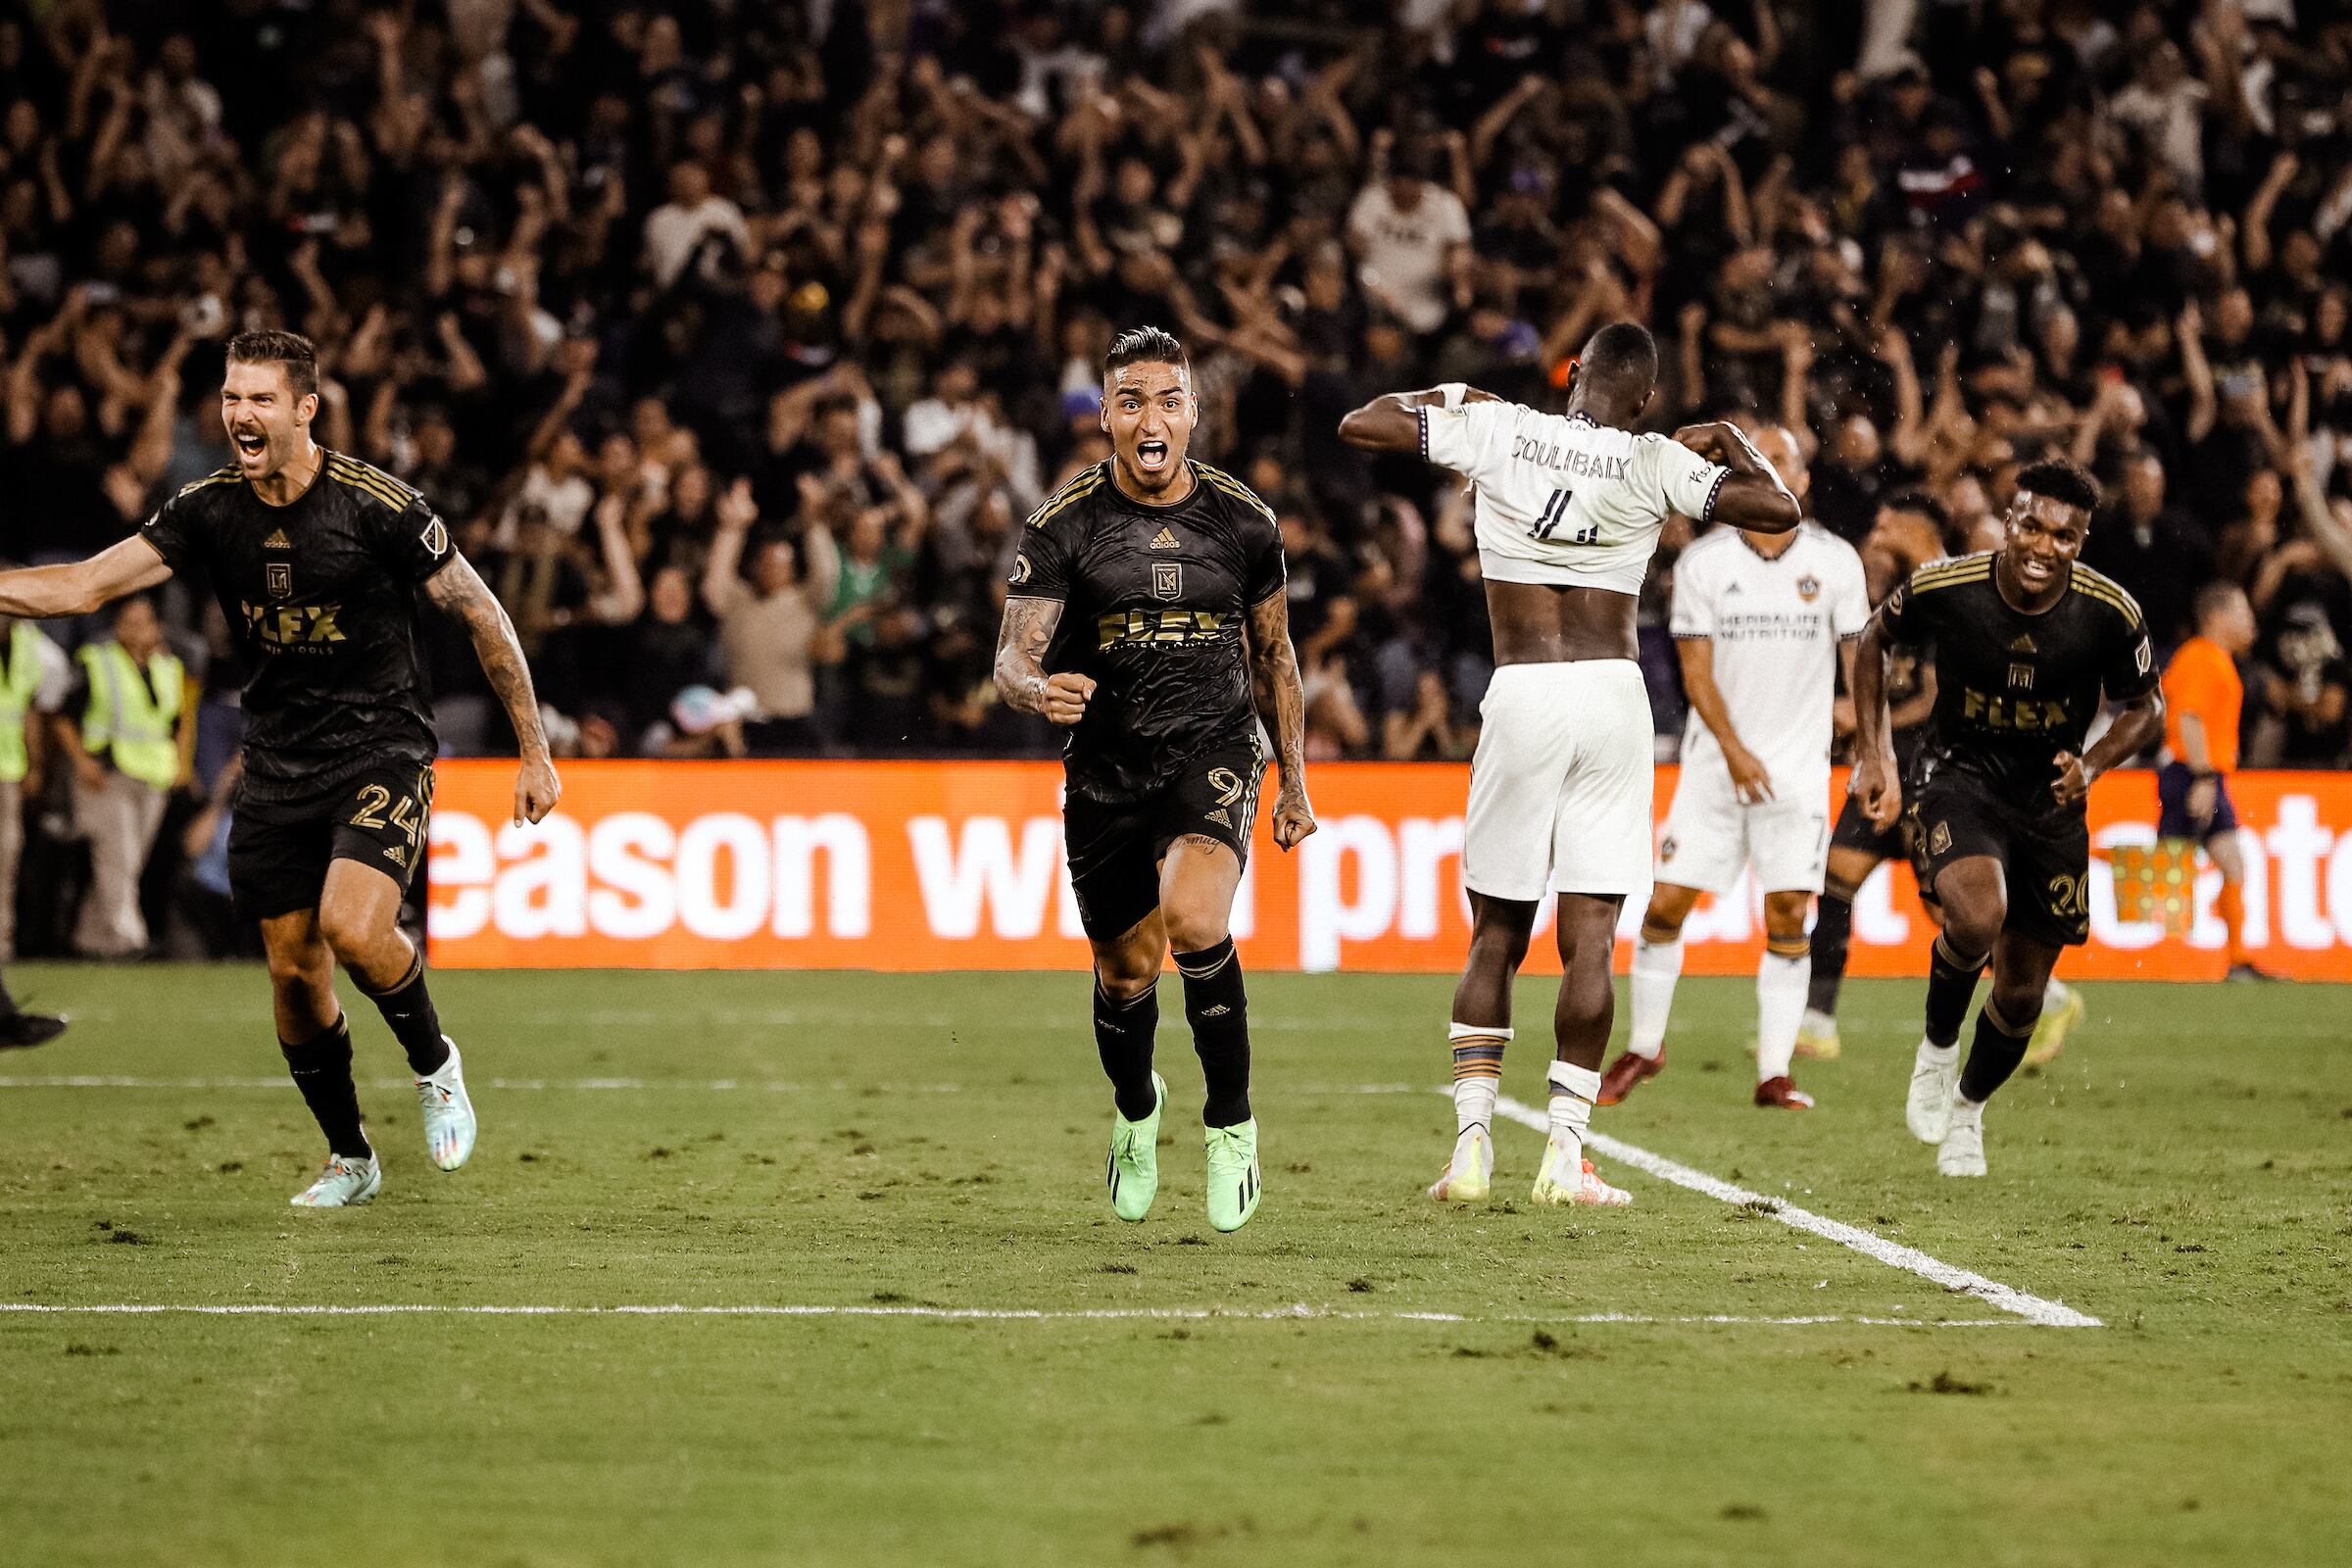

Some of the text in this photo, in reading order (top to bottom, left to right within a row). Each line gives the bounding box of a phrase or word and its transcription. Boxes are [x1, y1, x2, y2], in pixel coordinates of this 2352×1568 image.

[1149, 540, 1181, 550] adidas
[1964, 687, 2069, 730] FLEX
[1207, 767, 1244, 808] 9
[349, 783, 419, 847] 24
